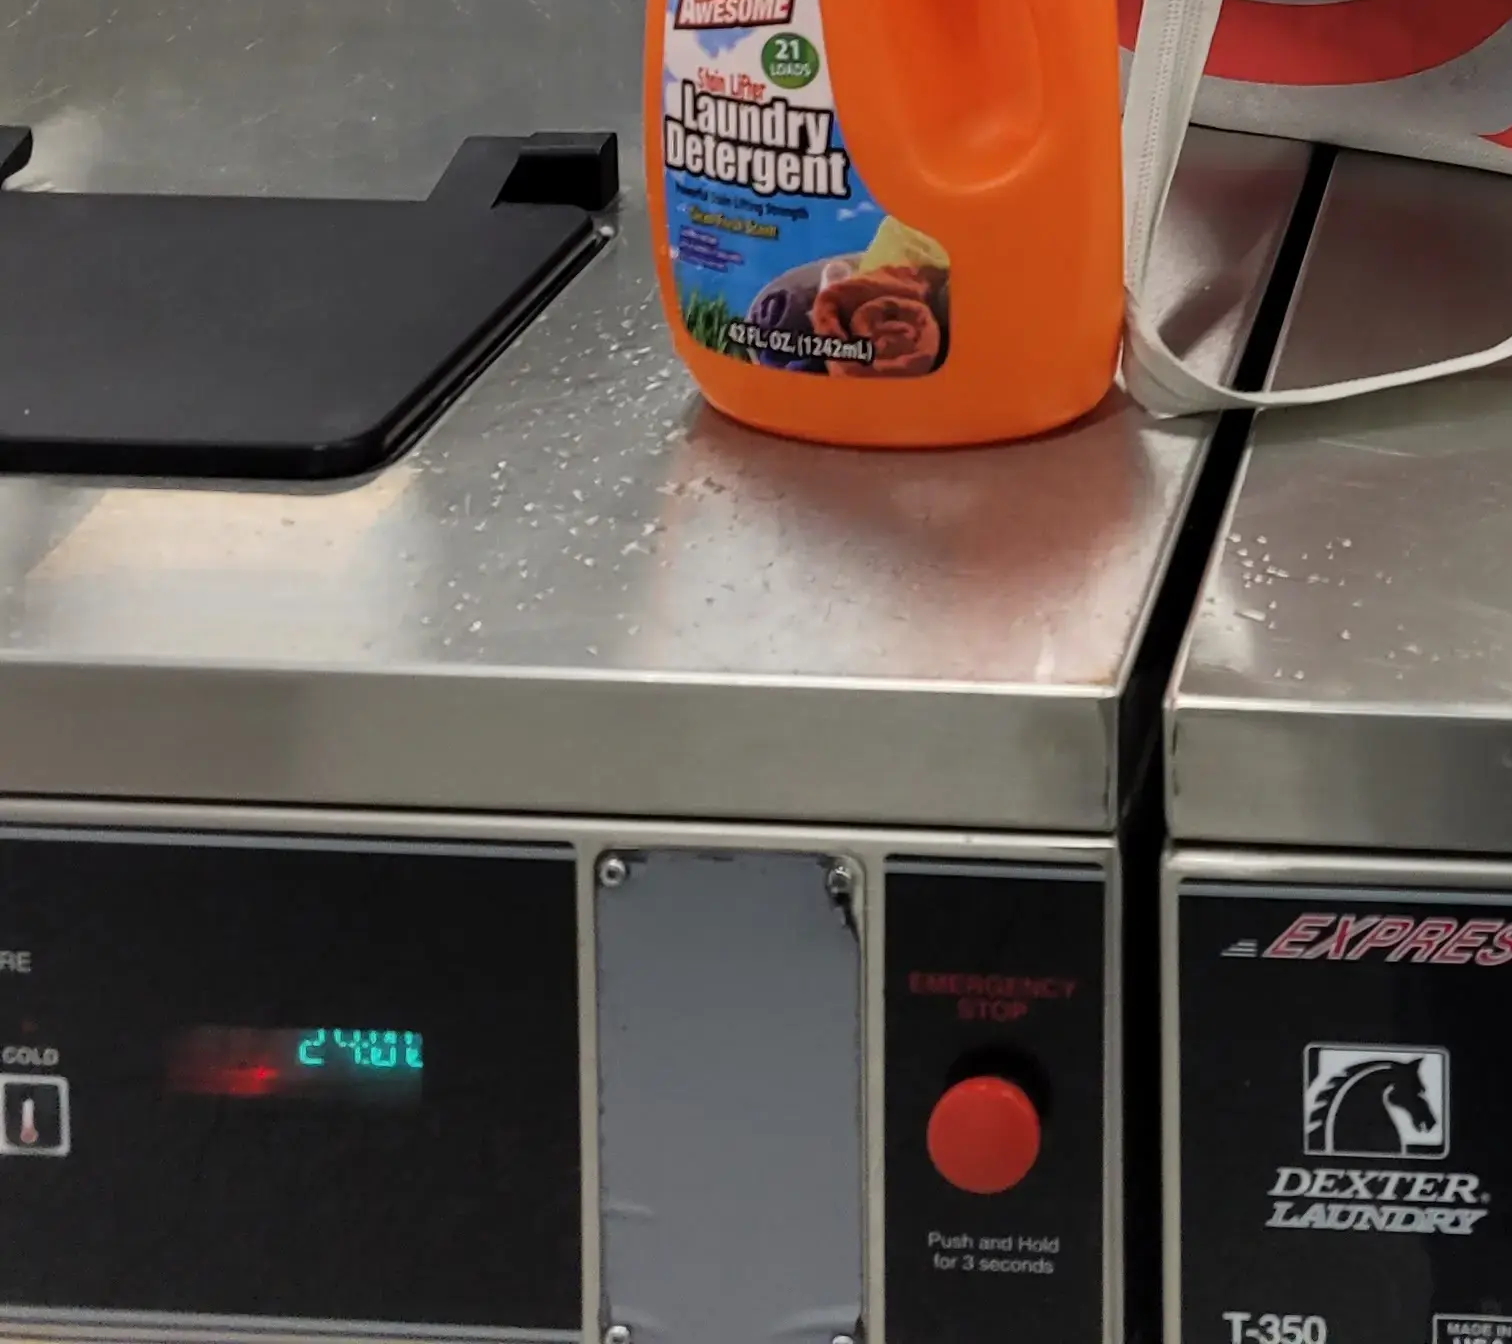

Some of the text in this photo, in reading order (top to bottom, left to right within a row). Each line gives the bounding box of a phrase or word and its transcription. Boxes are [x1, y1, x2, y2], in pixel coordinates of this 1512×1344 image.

[774, 39, 801, 60] 21
[769, 62, 812, 77] LOADS
[682, 79, 833, 156] Laundry
[665, 118, 849, 198] Detergent
[797, 333, 873, 363] (1242mL)
[907, 971, 1078, 1001] EMERGENCY
[957, 996, 1029, 1023] STOP
[2, 1046, 59, 1066] COLD
[1265, 1200, 1489, 1236] LAUNDRY
[928, 1231, 1060, 1254] Push and Hold
[933, 1253, 1054, 1275] for 3 seconds
[1446, 1322, 1512, 1338] MADE IN
